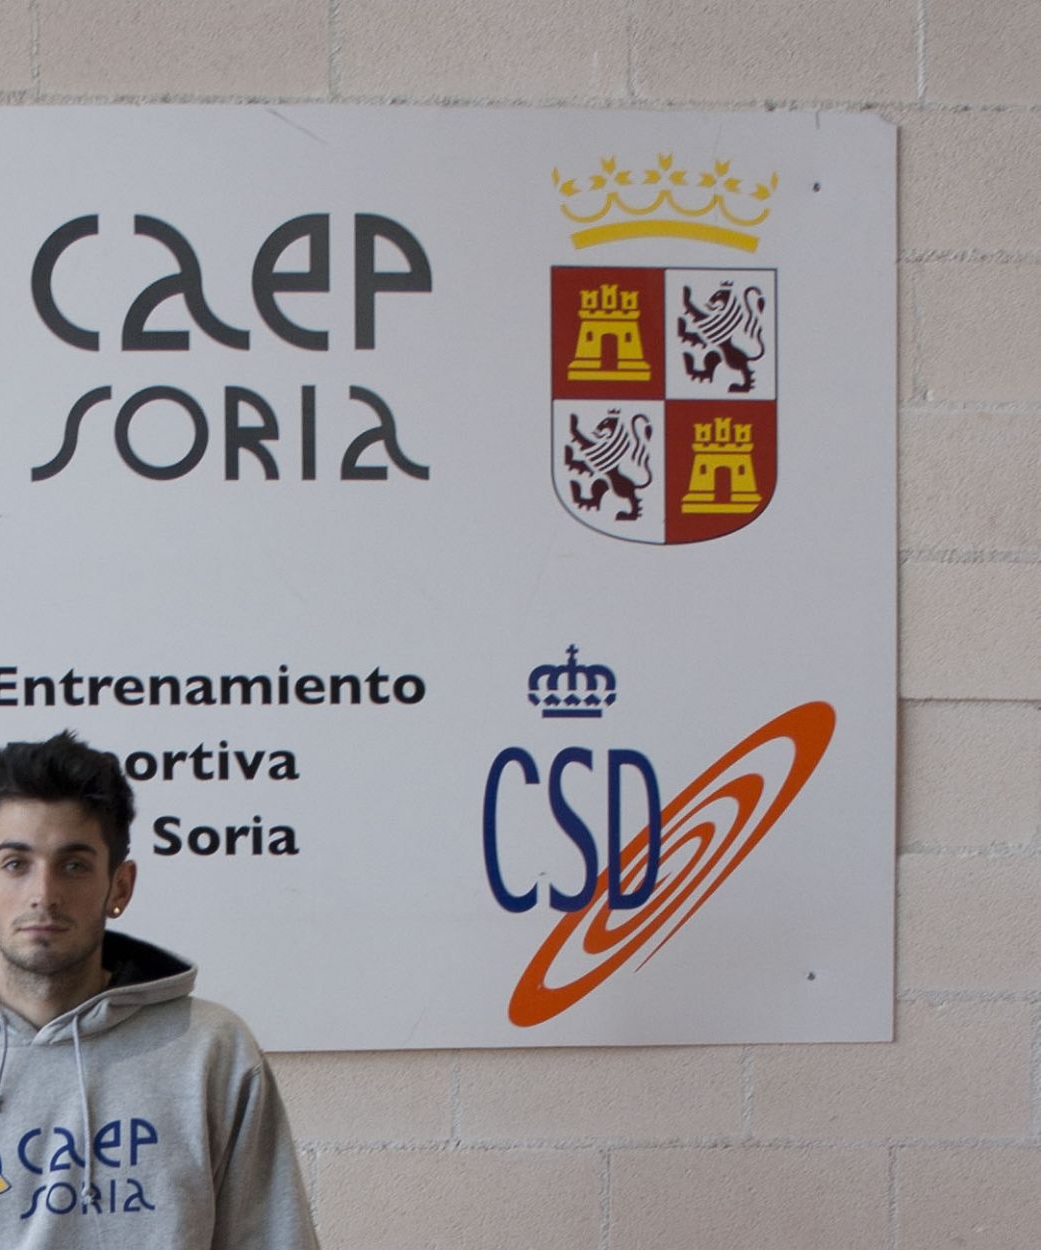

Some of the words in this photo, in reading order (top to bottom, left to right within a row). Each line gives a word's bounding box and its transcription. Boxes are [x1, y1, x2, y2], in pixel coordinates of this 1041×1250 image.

[123, 741, 300, 782] ortiva
[152, 815, 300, 857] Soria
[483, 746, 662, 914] CSD
